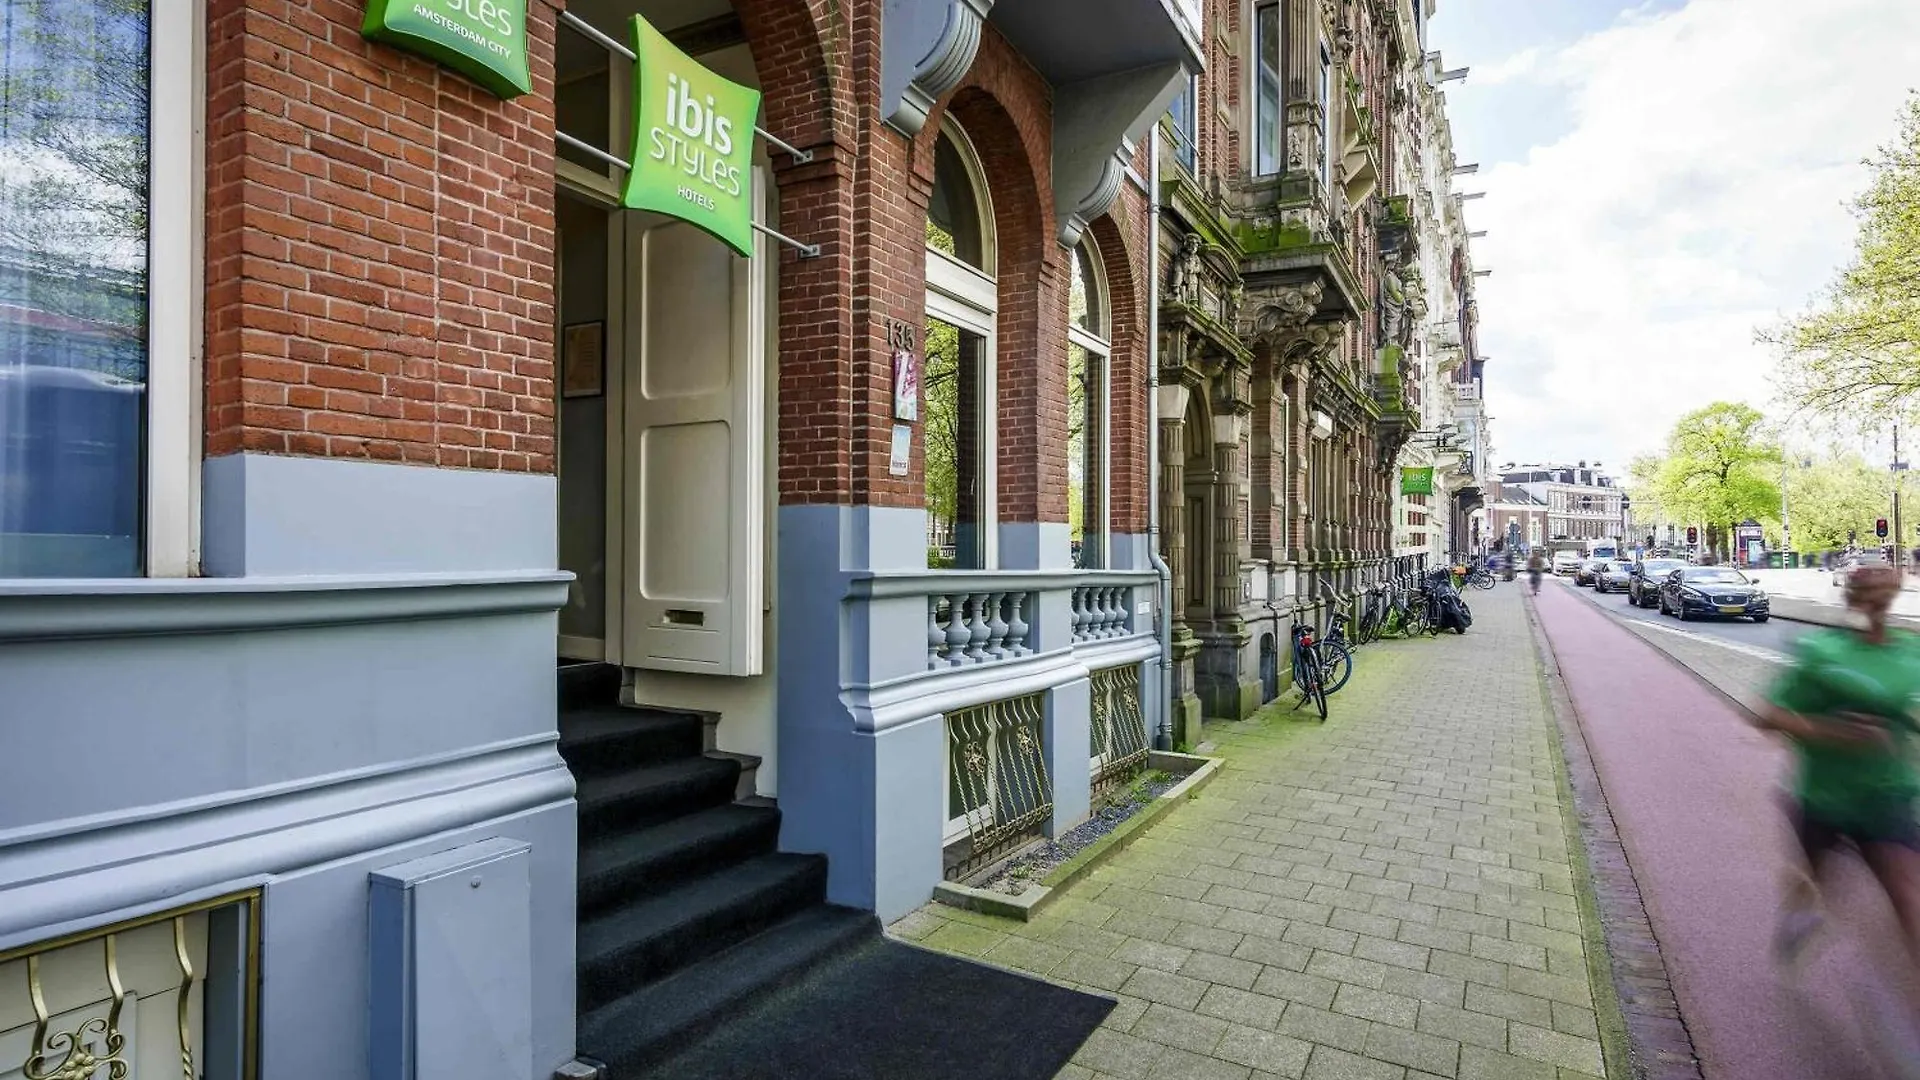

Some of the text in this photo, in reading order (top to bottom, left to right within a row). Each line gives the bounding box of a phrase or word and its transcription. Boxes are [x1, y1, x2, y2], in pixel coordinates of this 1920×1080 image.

[413, 4, 511, 59] AMSTERDAM CITY
[667, 73, 732, 155] ibis
[678, 185, 715, 210] HOTELS
[887, 319, 914, 351] 135
